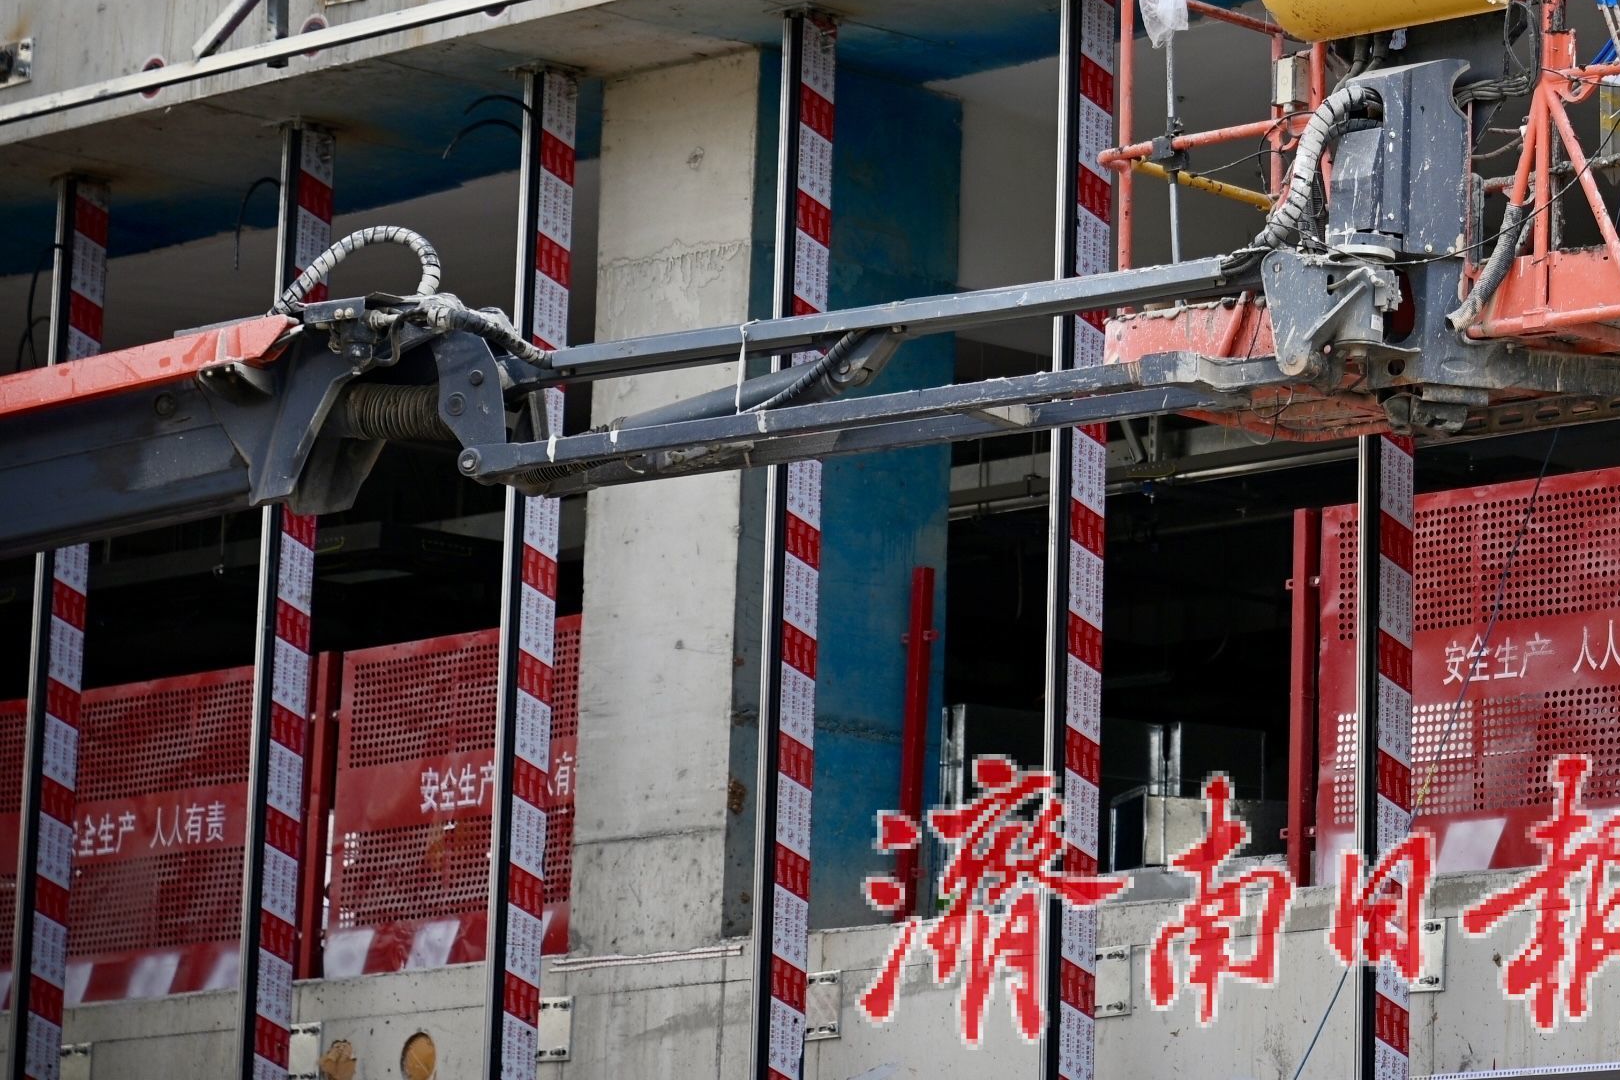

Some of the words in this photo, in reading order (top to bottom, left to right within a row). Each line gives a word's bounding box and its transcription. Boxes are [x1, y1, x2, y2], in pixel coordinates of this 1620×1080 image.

[1442, 632, 1556, 686] 安全生产
[420, 760, 495, 813] 安全生产
[150, 800, 226, 849] 人人有责
